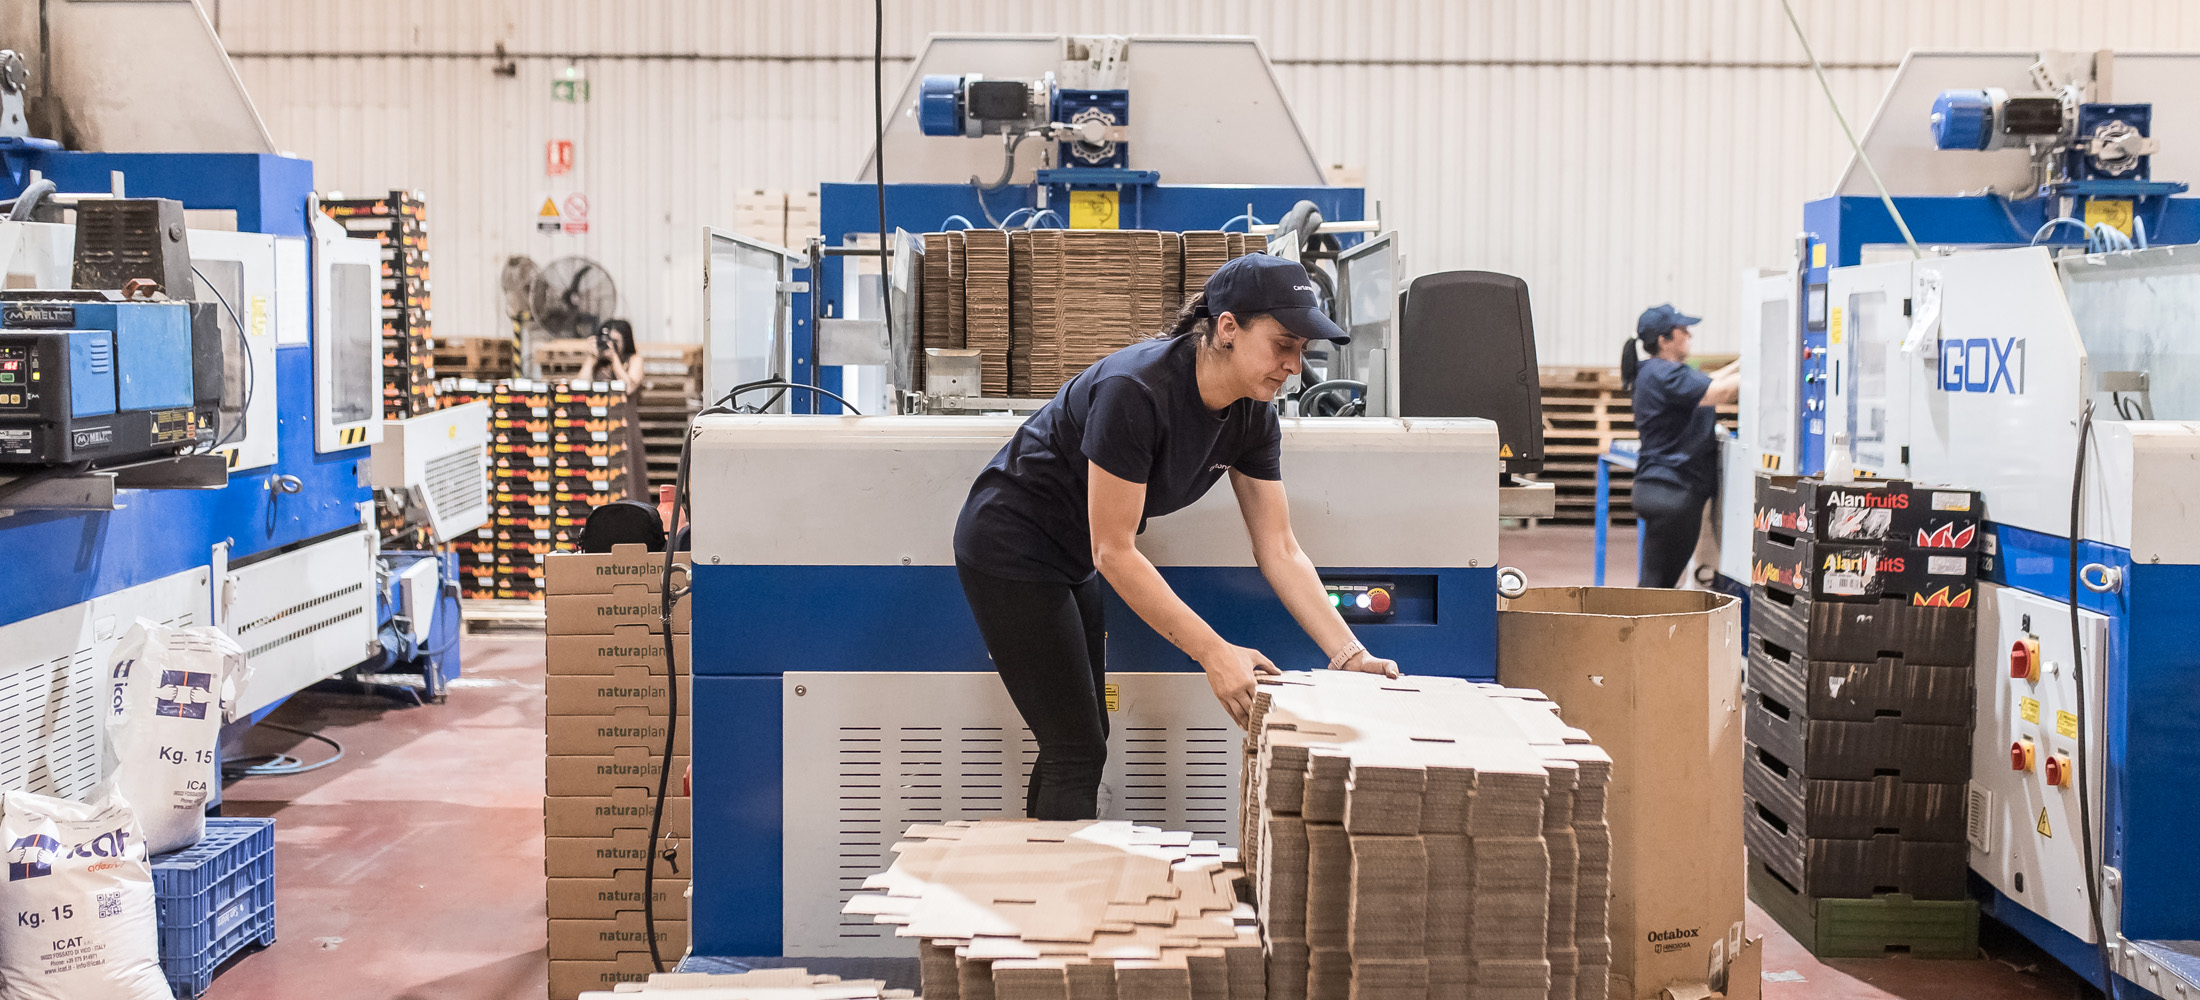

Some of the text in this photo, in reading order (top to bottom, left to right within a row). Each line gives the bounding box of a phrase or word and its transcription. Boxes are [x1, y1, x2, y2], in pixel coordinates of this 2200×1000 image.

[596, 562, 665, 577] naturaplan
[598, 645, 666, 659] naturaplan
[113, 683, 128, 716] icat
[598, 686, 666, 700] naturaplan
[598, 726, 666, 740] naturaplan
[159, 746, 213, 765] Kg. 15
[18, 904, 74, 929] Kg. 15
[1648, 928, 1699, 943] Octabox
[53, 937, 83, 951] ICAT
